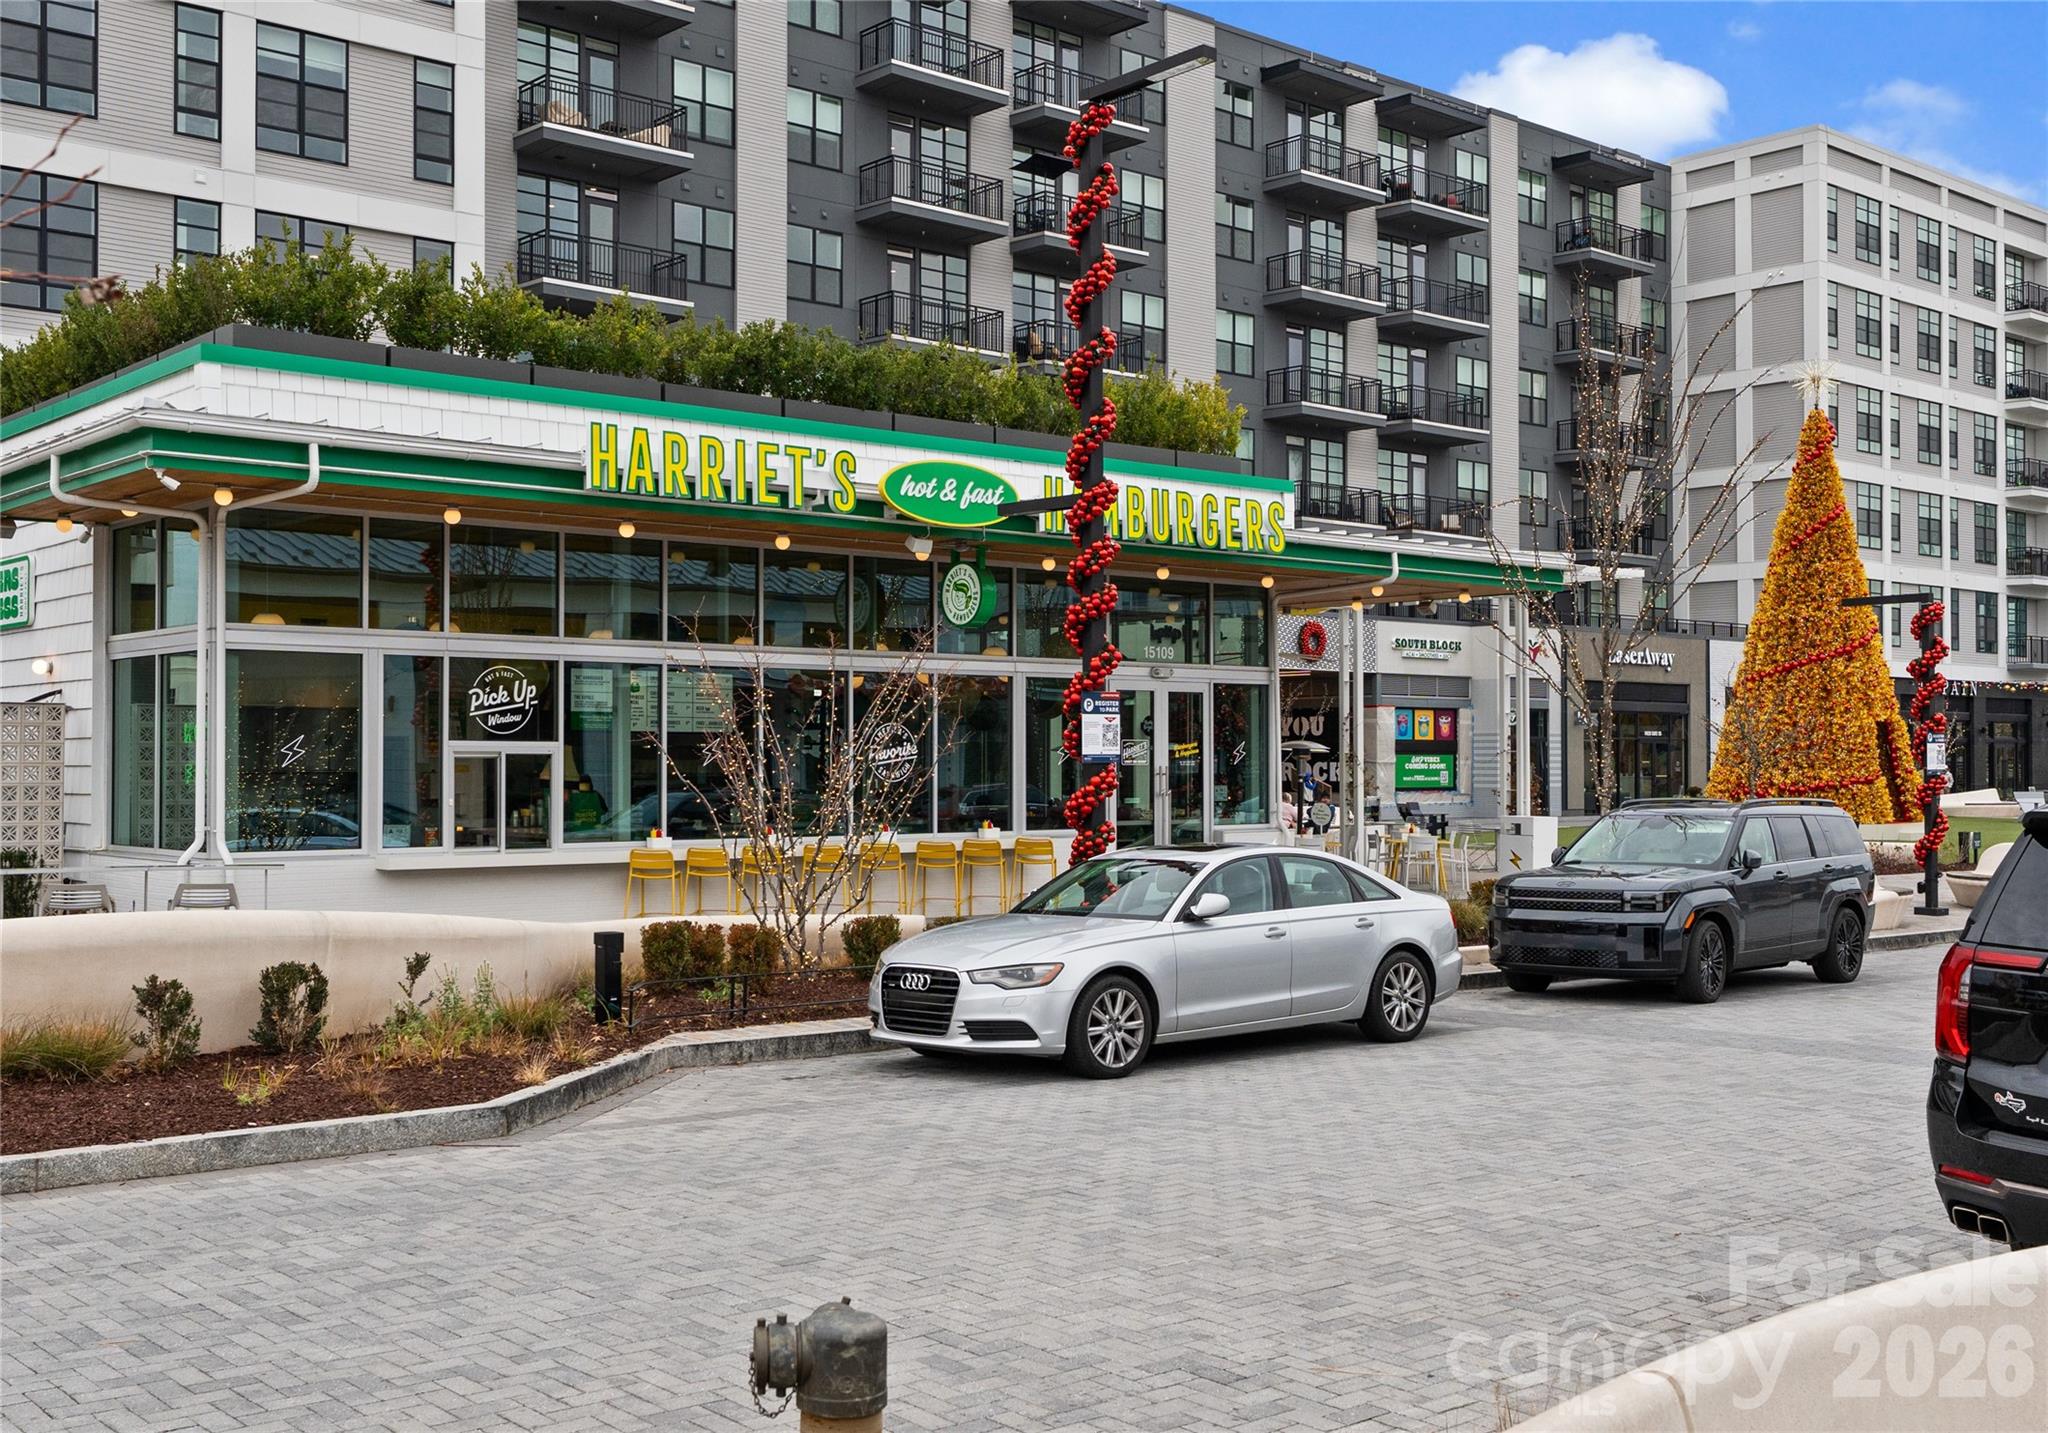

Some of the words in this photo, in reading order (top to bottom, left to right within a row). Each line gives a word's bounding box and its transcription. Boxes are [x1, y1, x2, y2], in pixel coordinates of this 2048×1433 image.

[589, 421, 857, 513] HARRIET'S
[899, 474, 937, 499] hot
[939, 478, 957, 502] &
[958, 479, 1005, 509] fast
[1044, 474, 1287, 554] HBURGERS
[1143, 645, 1175, 660] 15109
[1394, 638, 1428, 650] SOUTH
[1429, 639, 1462, 651] BLOCK
[1608, 647, 1676, 672] LaserAway
[468, 684, 511, 712] Pick
[513, 678, 537, 710] Up
[487, 712, 523, 727] Window
[1281, 715, 1325, 737] YOU
[1404, 762, 1429, 770] COMING
